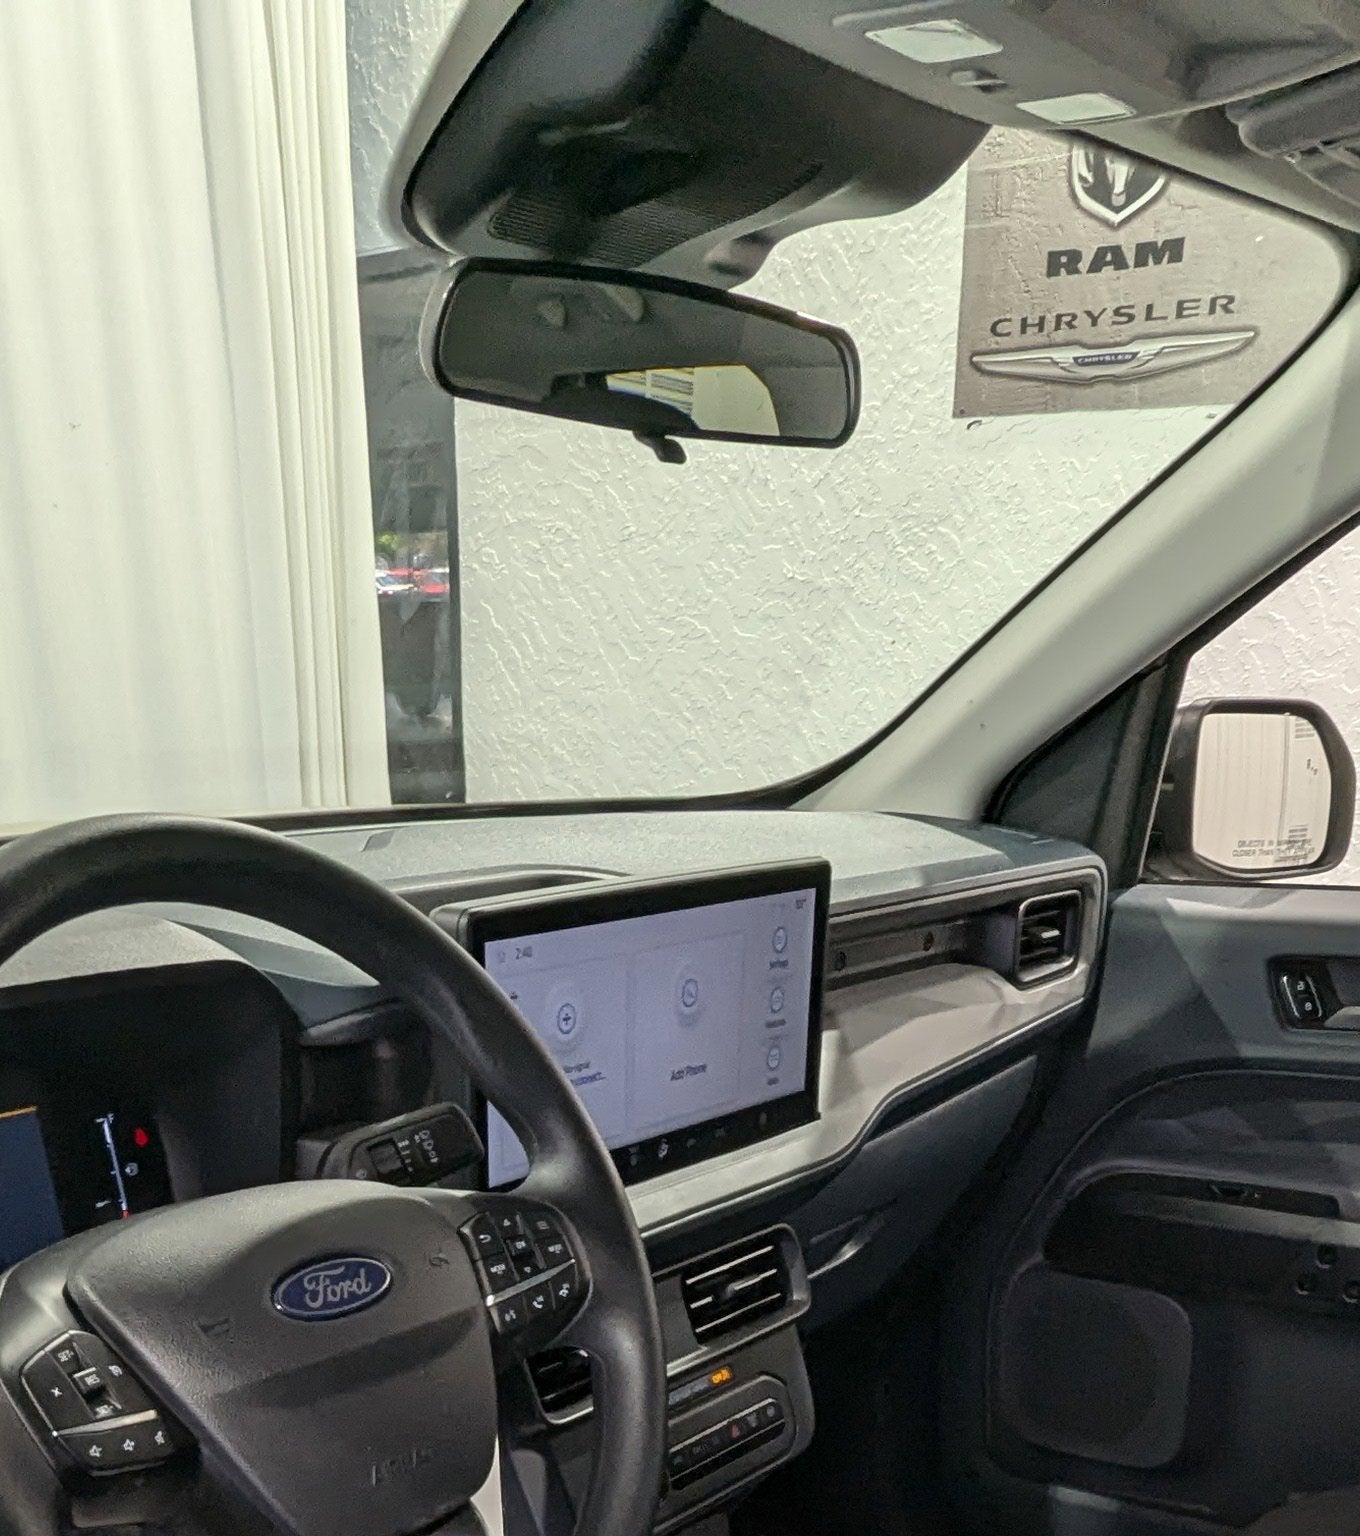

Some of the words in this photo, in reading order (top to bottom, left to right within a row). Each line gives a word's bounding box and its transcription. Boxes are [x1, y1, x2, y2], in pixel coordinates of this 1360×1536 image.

[1046, 236, 1185, 278] RAM
[989, 294, 1236, 338] CHRYSLER
[304, 1265, 372, 1309] Ford
